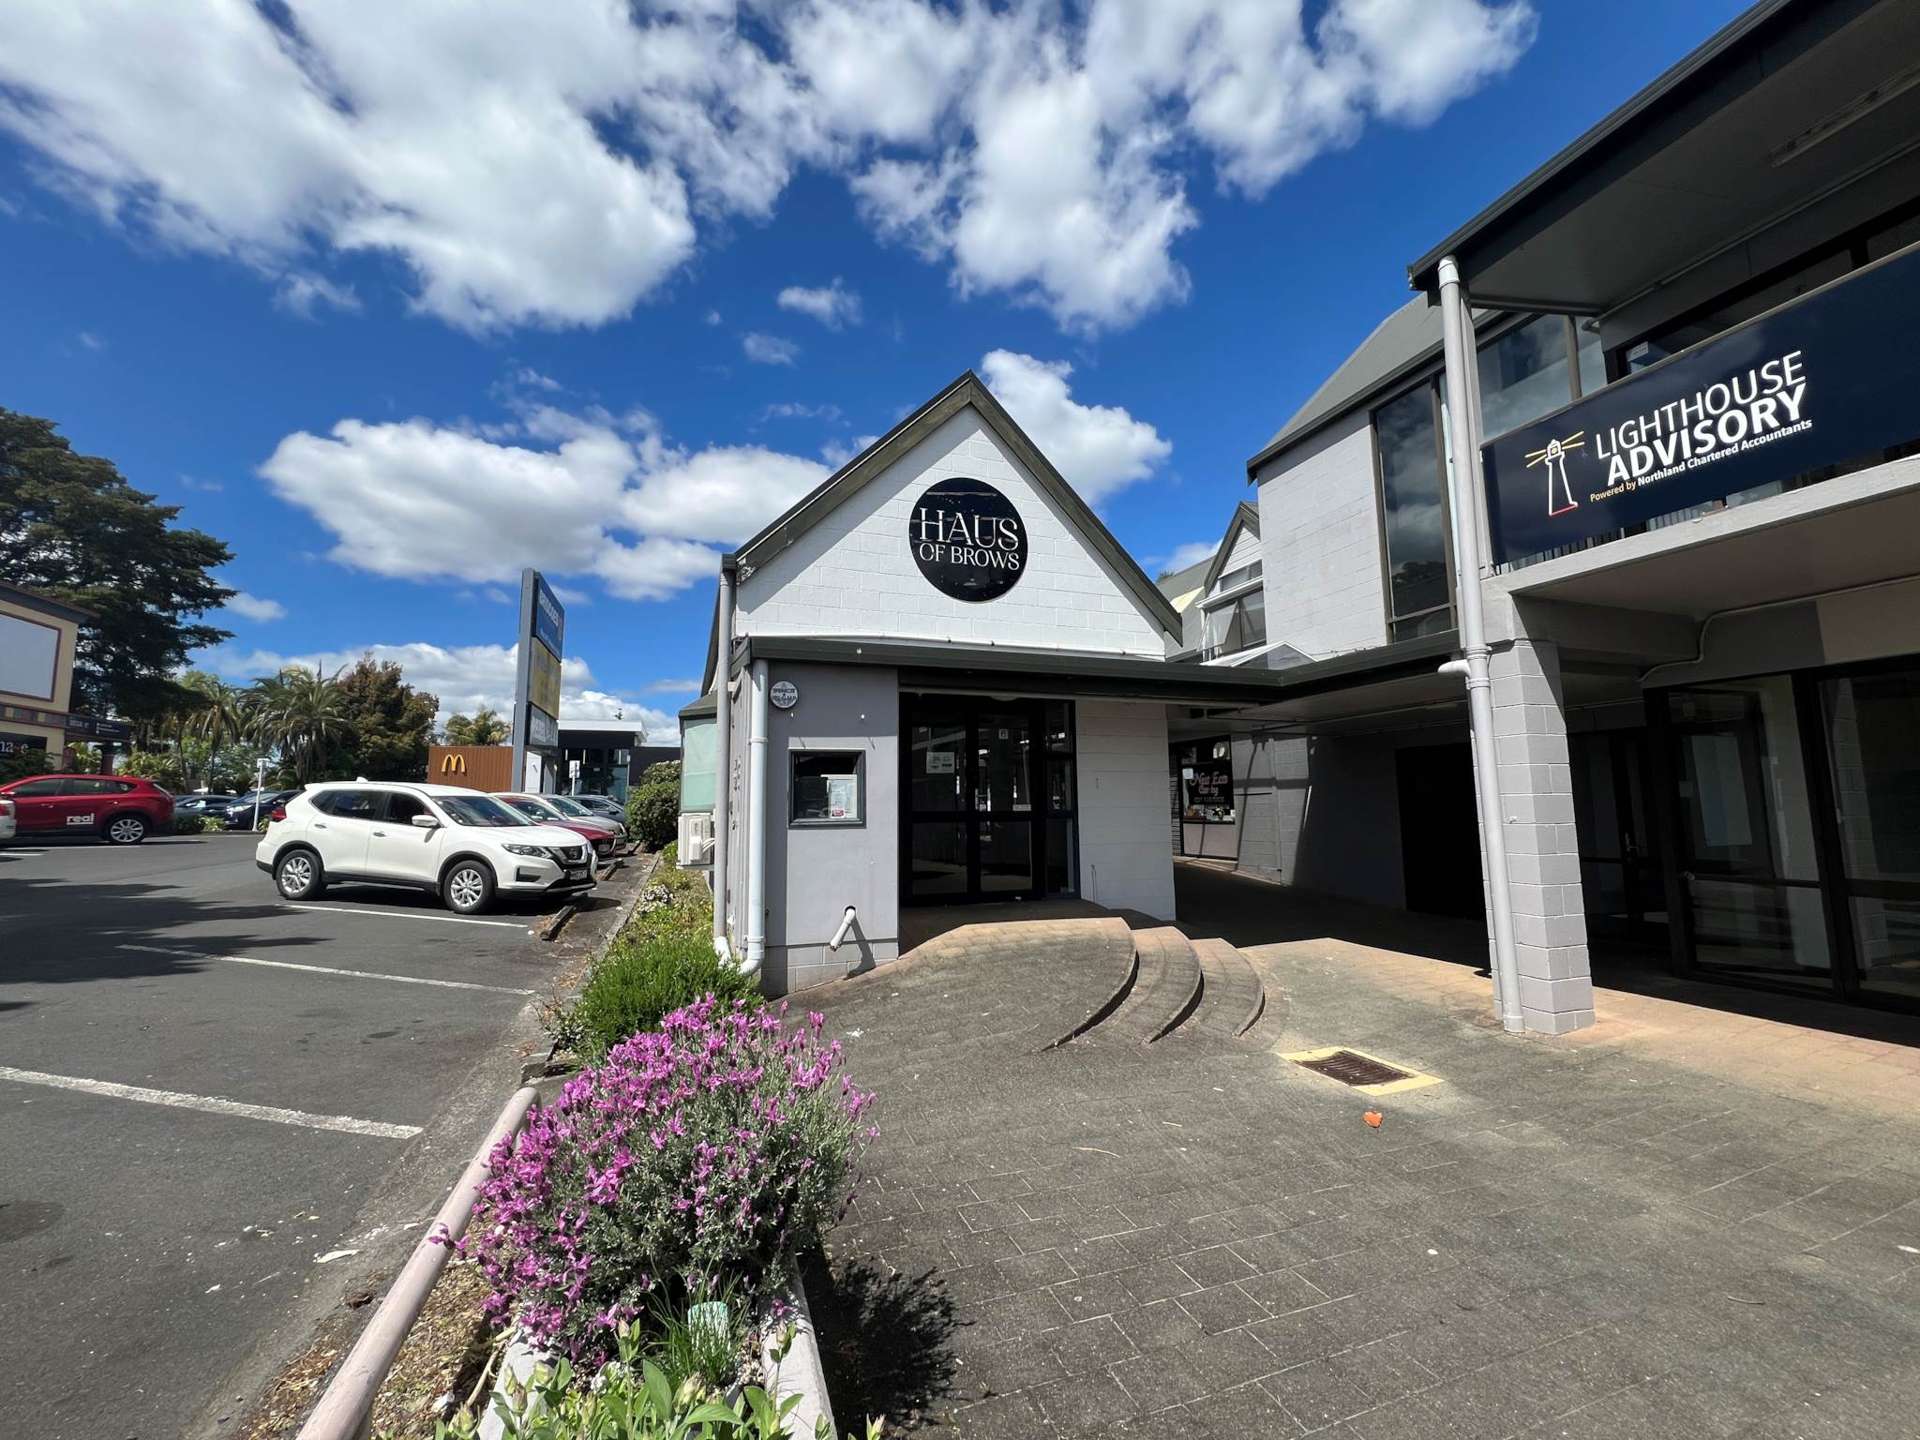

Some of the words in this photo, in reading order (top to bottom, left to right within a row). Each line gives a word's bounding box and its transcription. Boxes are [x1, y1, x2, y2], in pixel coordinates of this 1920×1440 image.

[1596, 350, 1806, 460] LIGHTHOUSE
[1607, 383, 1807, 486] ADVISORY
[1590, 483, 1625, 503] Powered
[1625, 480, 1637, 493] by
[1637, 462, 1685, 486] Northland
[1687, 444, 1739, 469] Chartered
[1740, 418, 1812, 451] Accountants
[919, 507, 1019, 551] HAUS
[919, 542, 946, 561] OF
[950, 546, 1020, 571] BROWS
[66, 812, 95, 822] real
